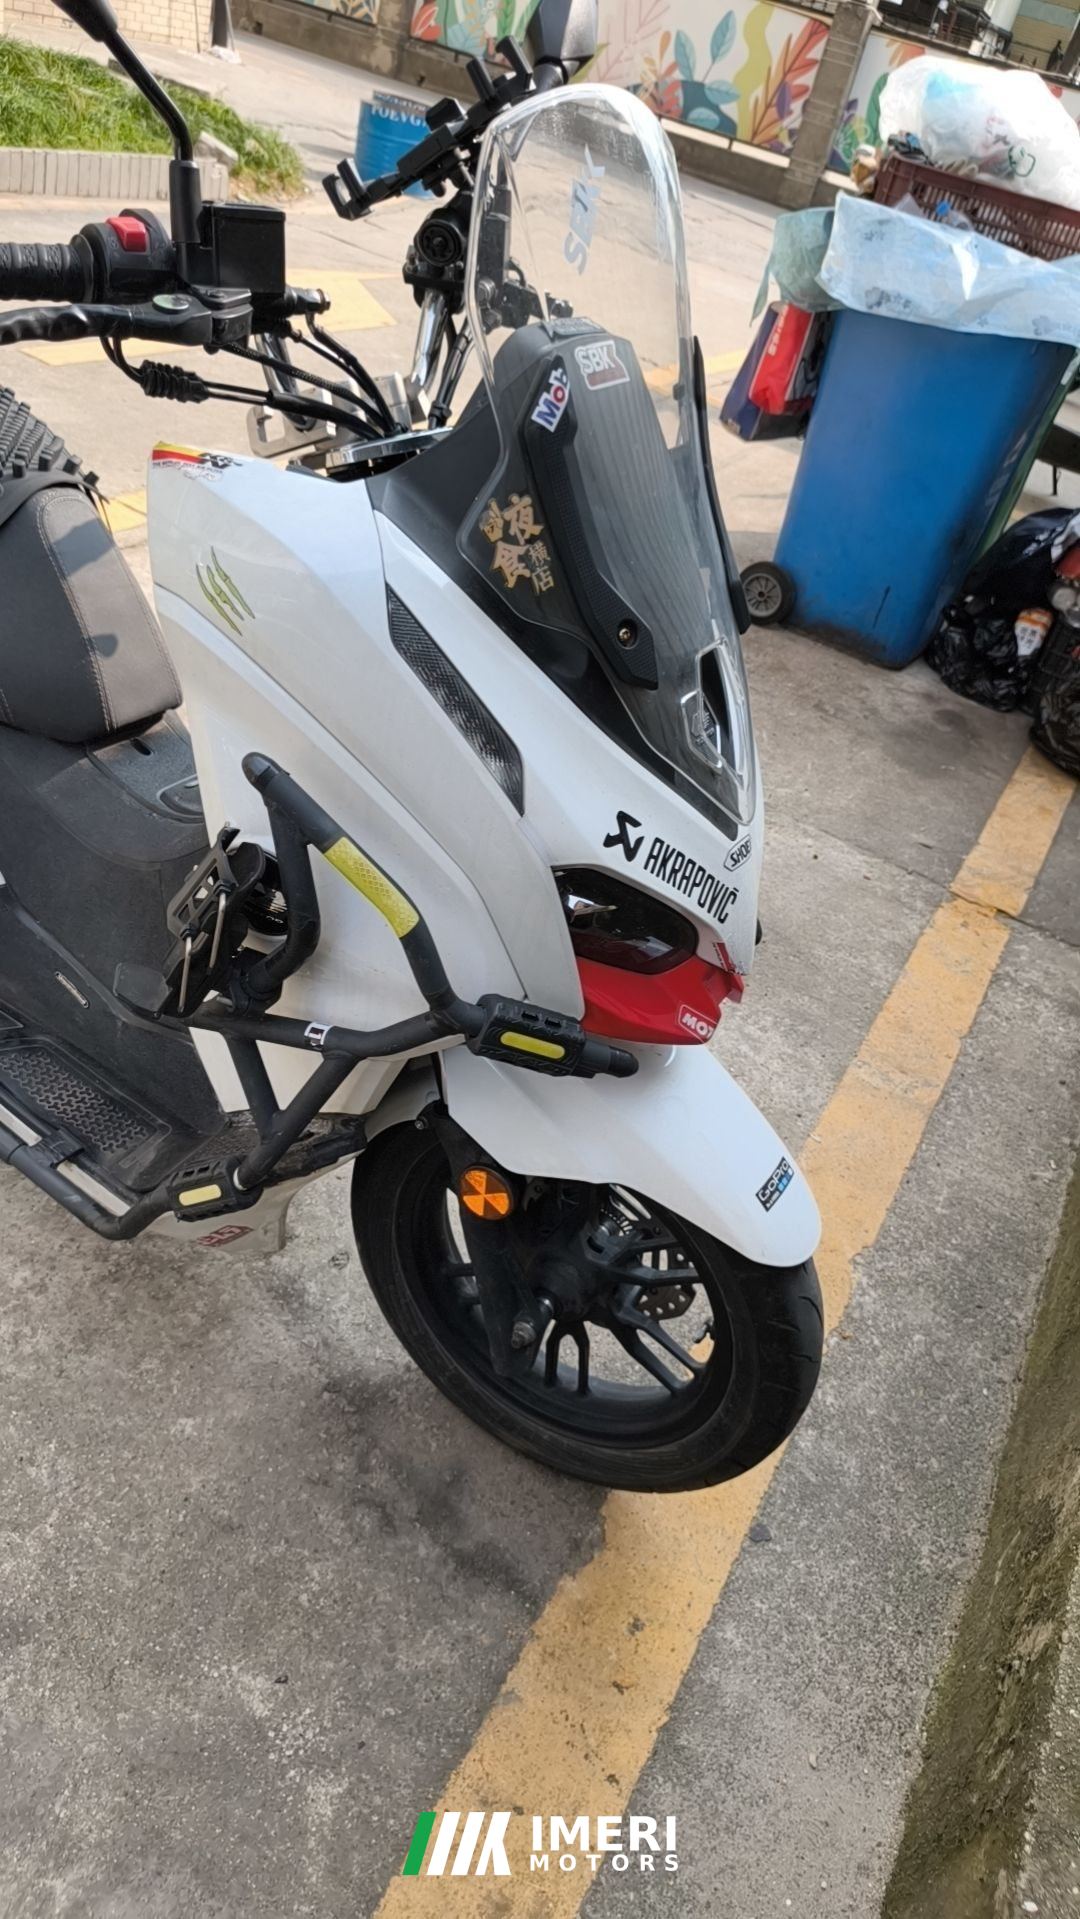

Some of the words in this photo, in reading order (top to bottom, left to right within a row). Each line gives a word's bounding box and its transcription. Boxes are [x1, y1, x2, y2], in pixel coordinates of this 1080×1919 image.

[579, 345, 616, 374] SBK
[644, 837, 739, 924] AKRAPOVIČ
[758, 1160, 789, 1202] GoPro
